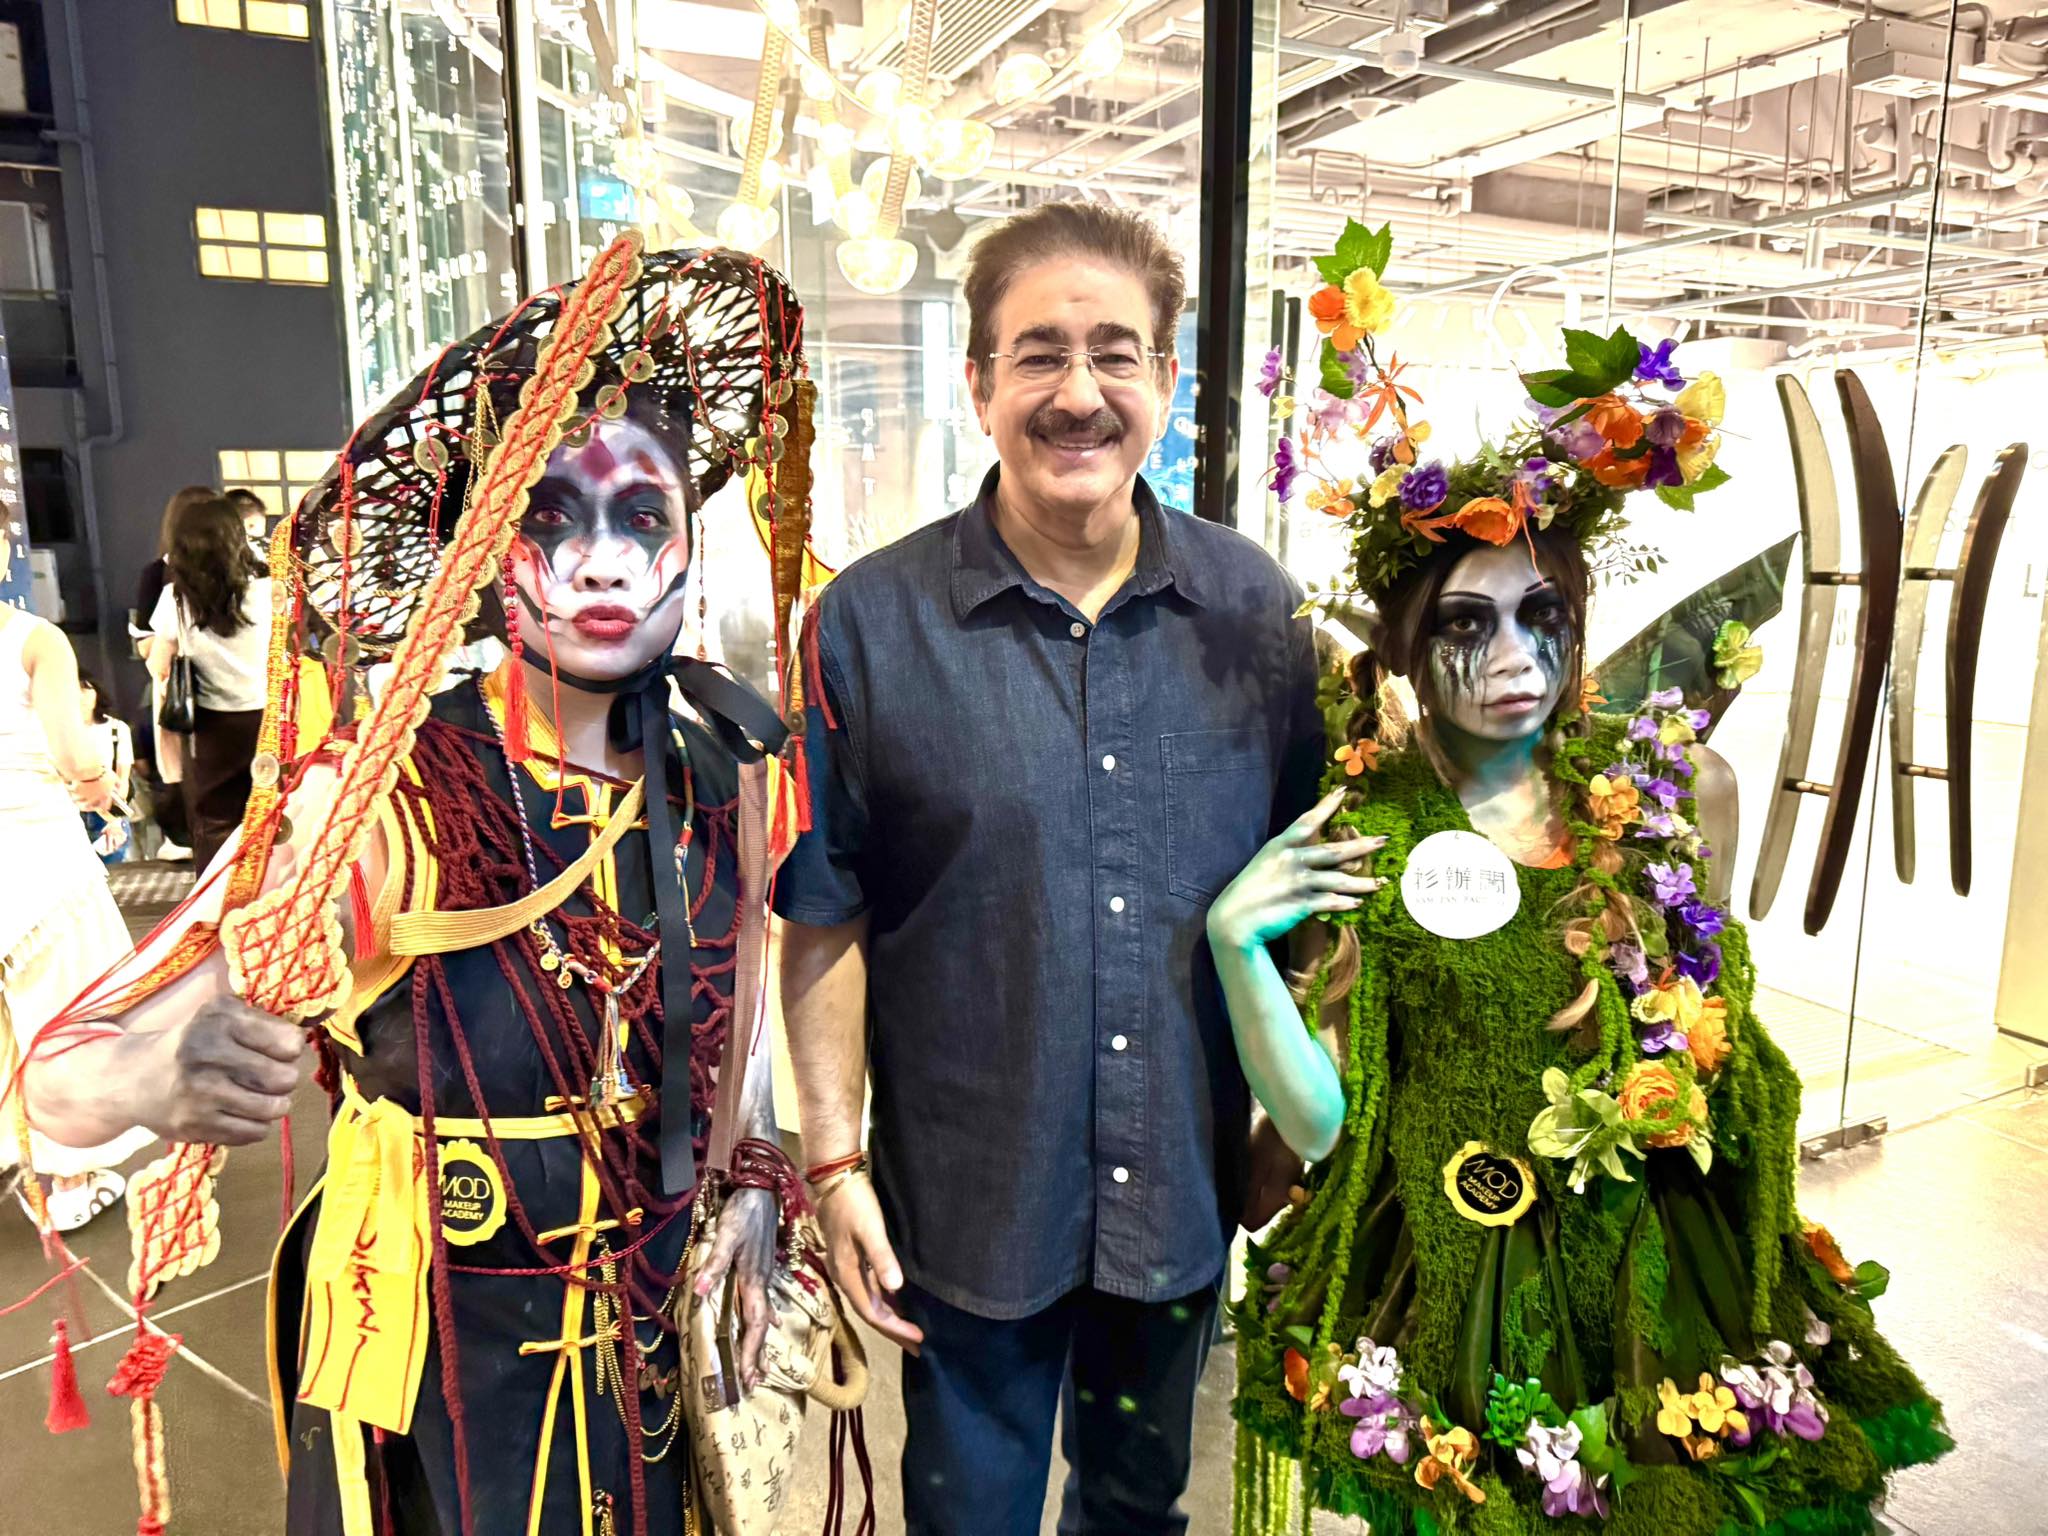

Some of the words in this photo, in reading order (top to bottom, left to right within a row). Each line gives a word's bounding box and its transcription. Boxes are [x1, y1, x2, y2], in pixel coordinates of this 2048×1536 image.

[439, 1175, 491, 1199] MOD
[1465, 1159, 1519, 1198] MOD
[1467, 1176, 1501, 1201] MAKEUP
[443, 1199, 482, 1210] MAKEUP
[1460, 1180, 1499, 1210] ACADEMY
[440, 1208, 484, 1221] ACADEMY
